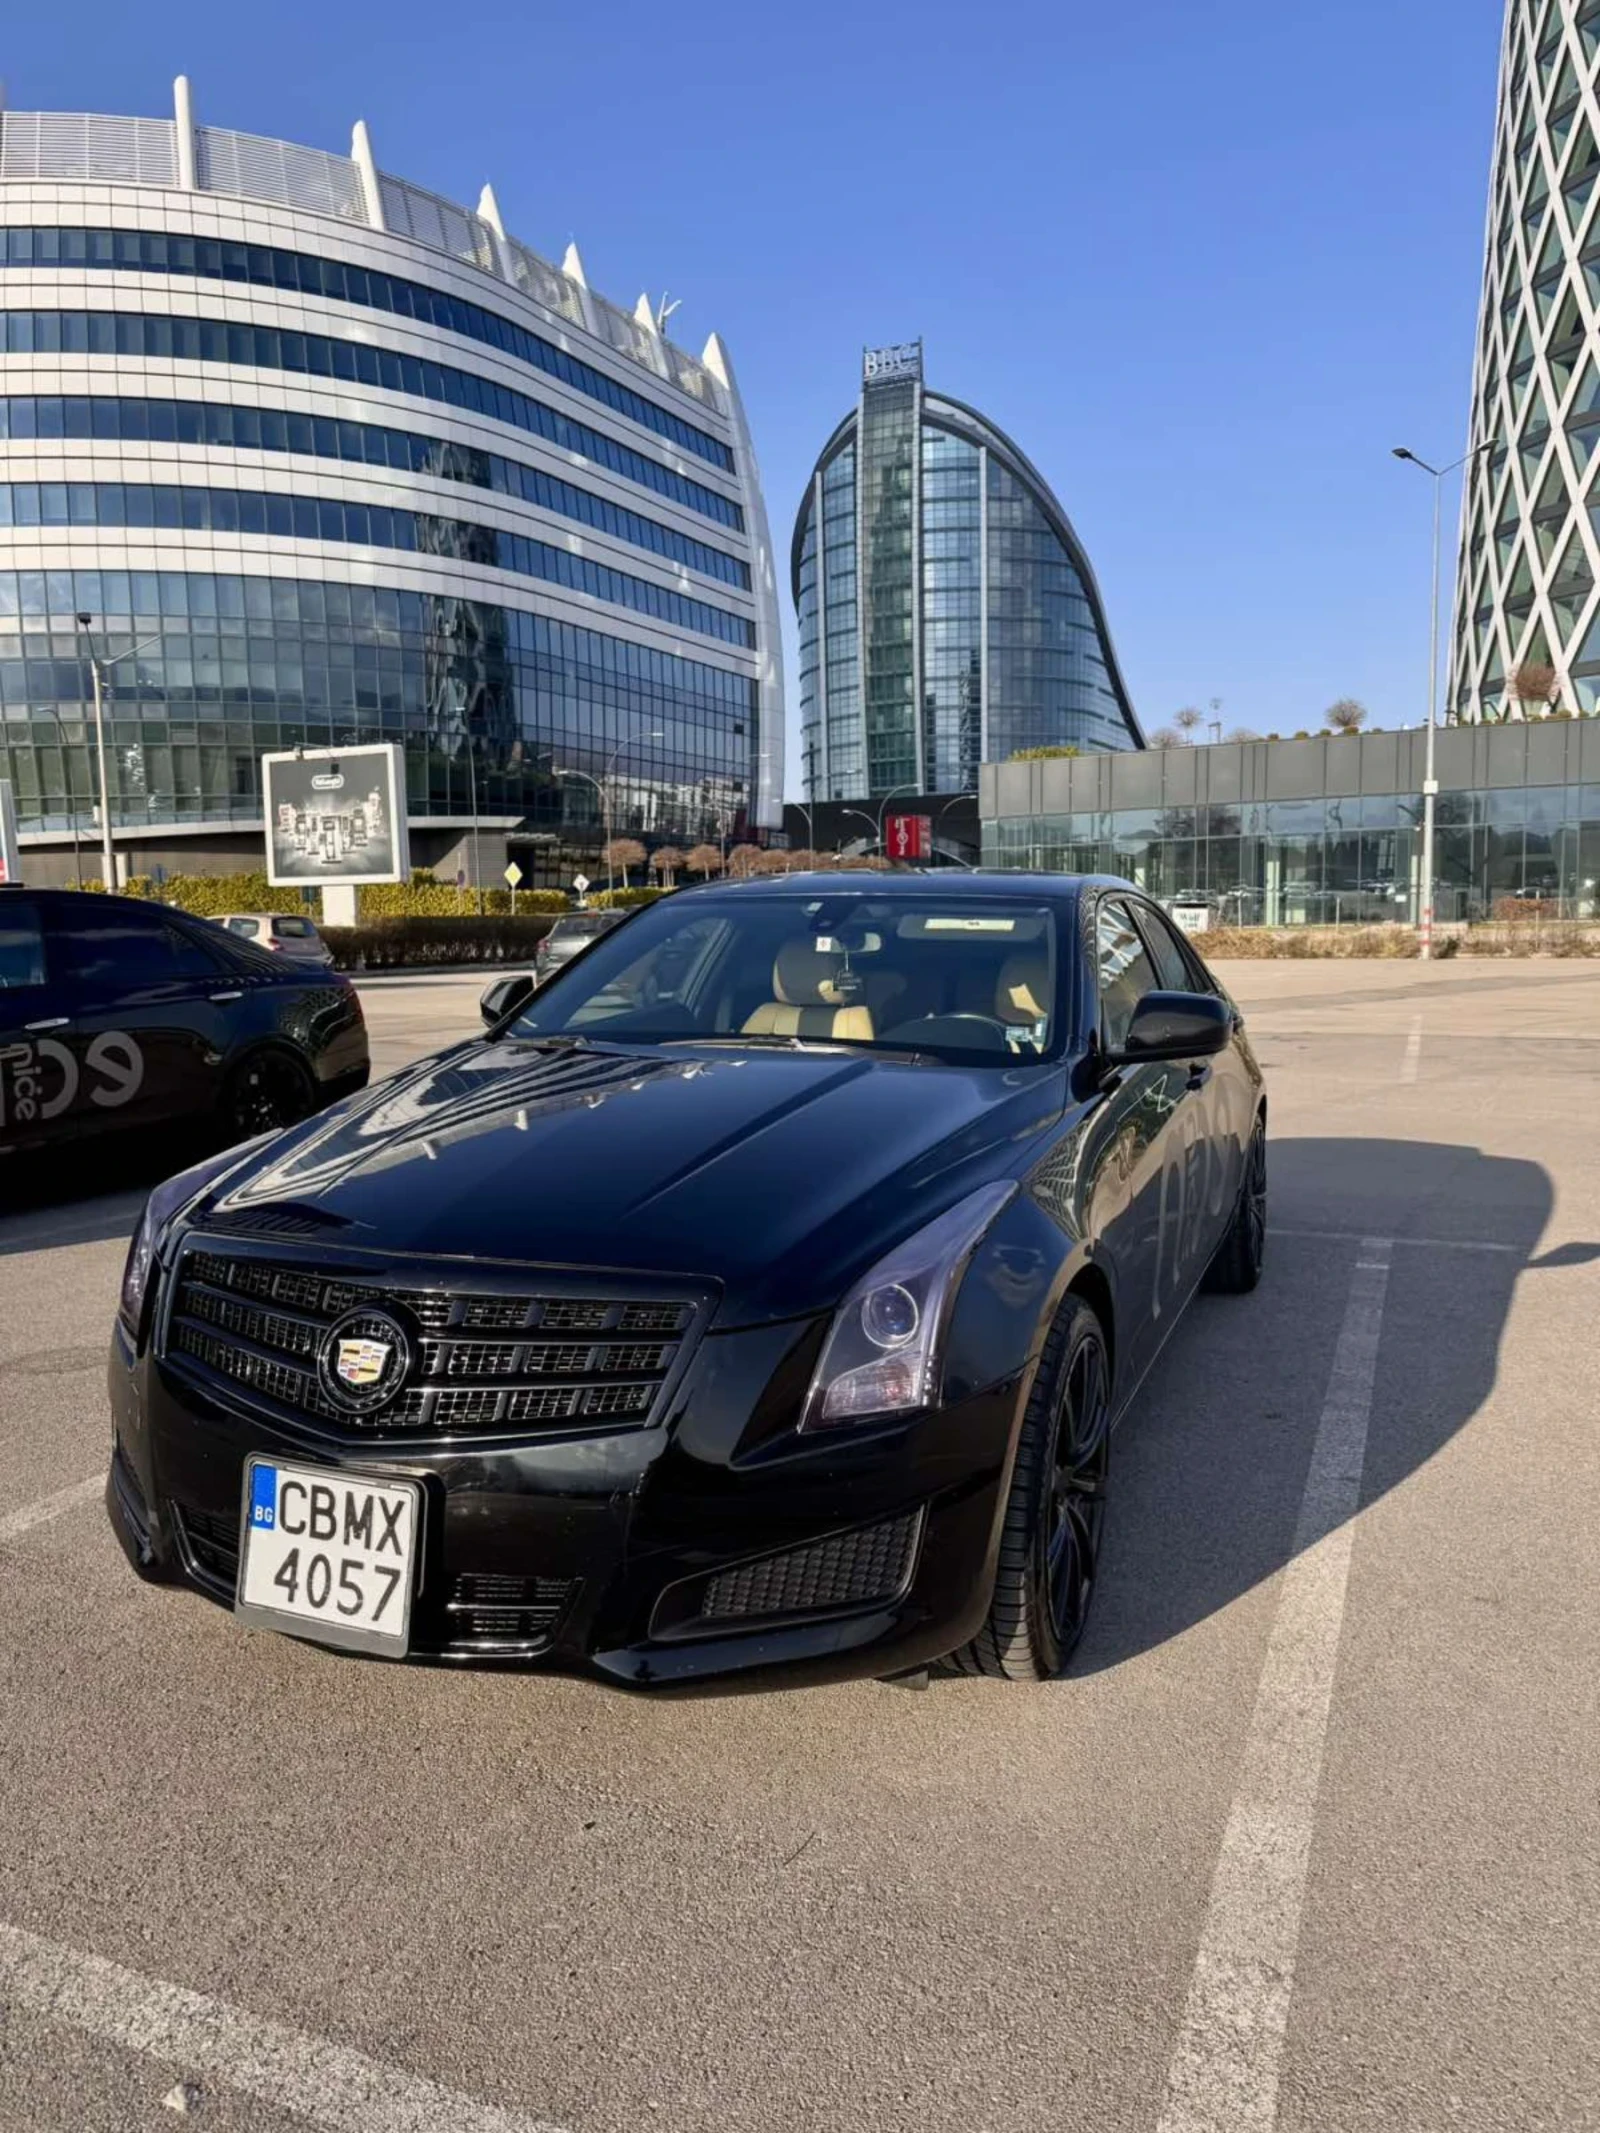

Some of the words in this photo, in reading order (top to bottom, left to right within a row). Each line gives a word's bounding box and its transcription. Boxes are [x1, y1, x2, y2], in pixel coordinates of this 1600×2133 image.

[254, 1504, 274, 1523] BG
[279, 1480, 405, 1556] CBMX
[273, 1548, 402, 1622] 4057
